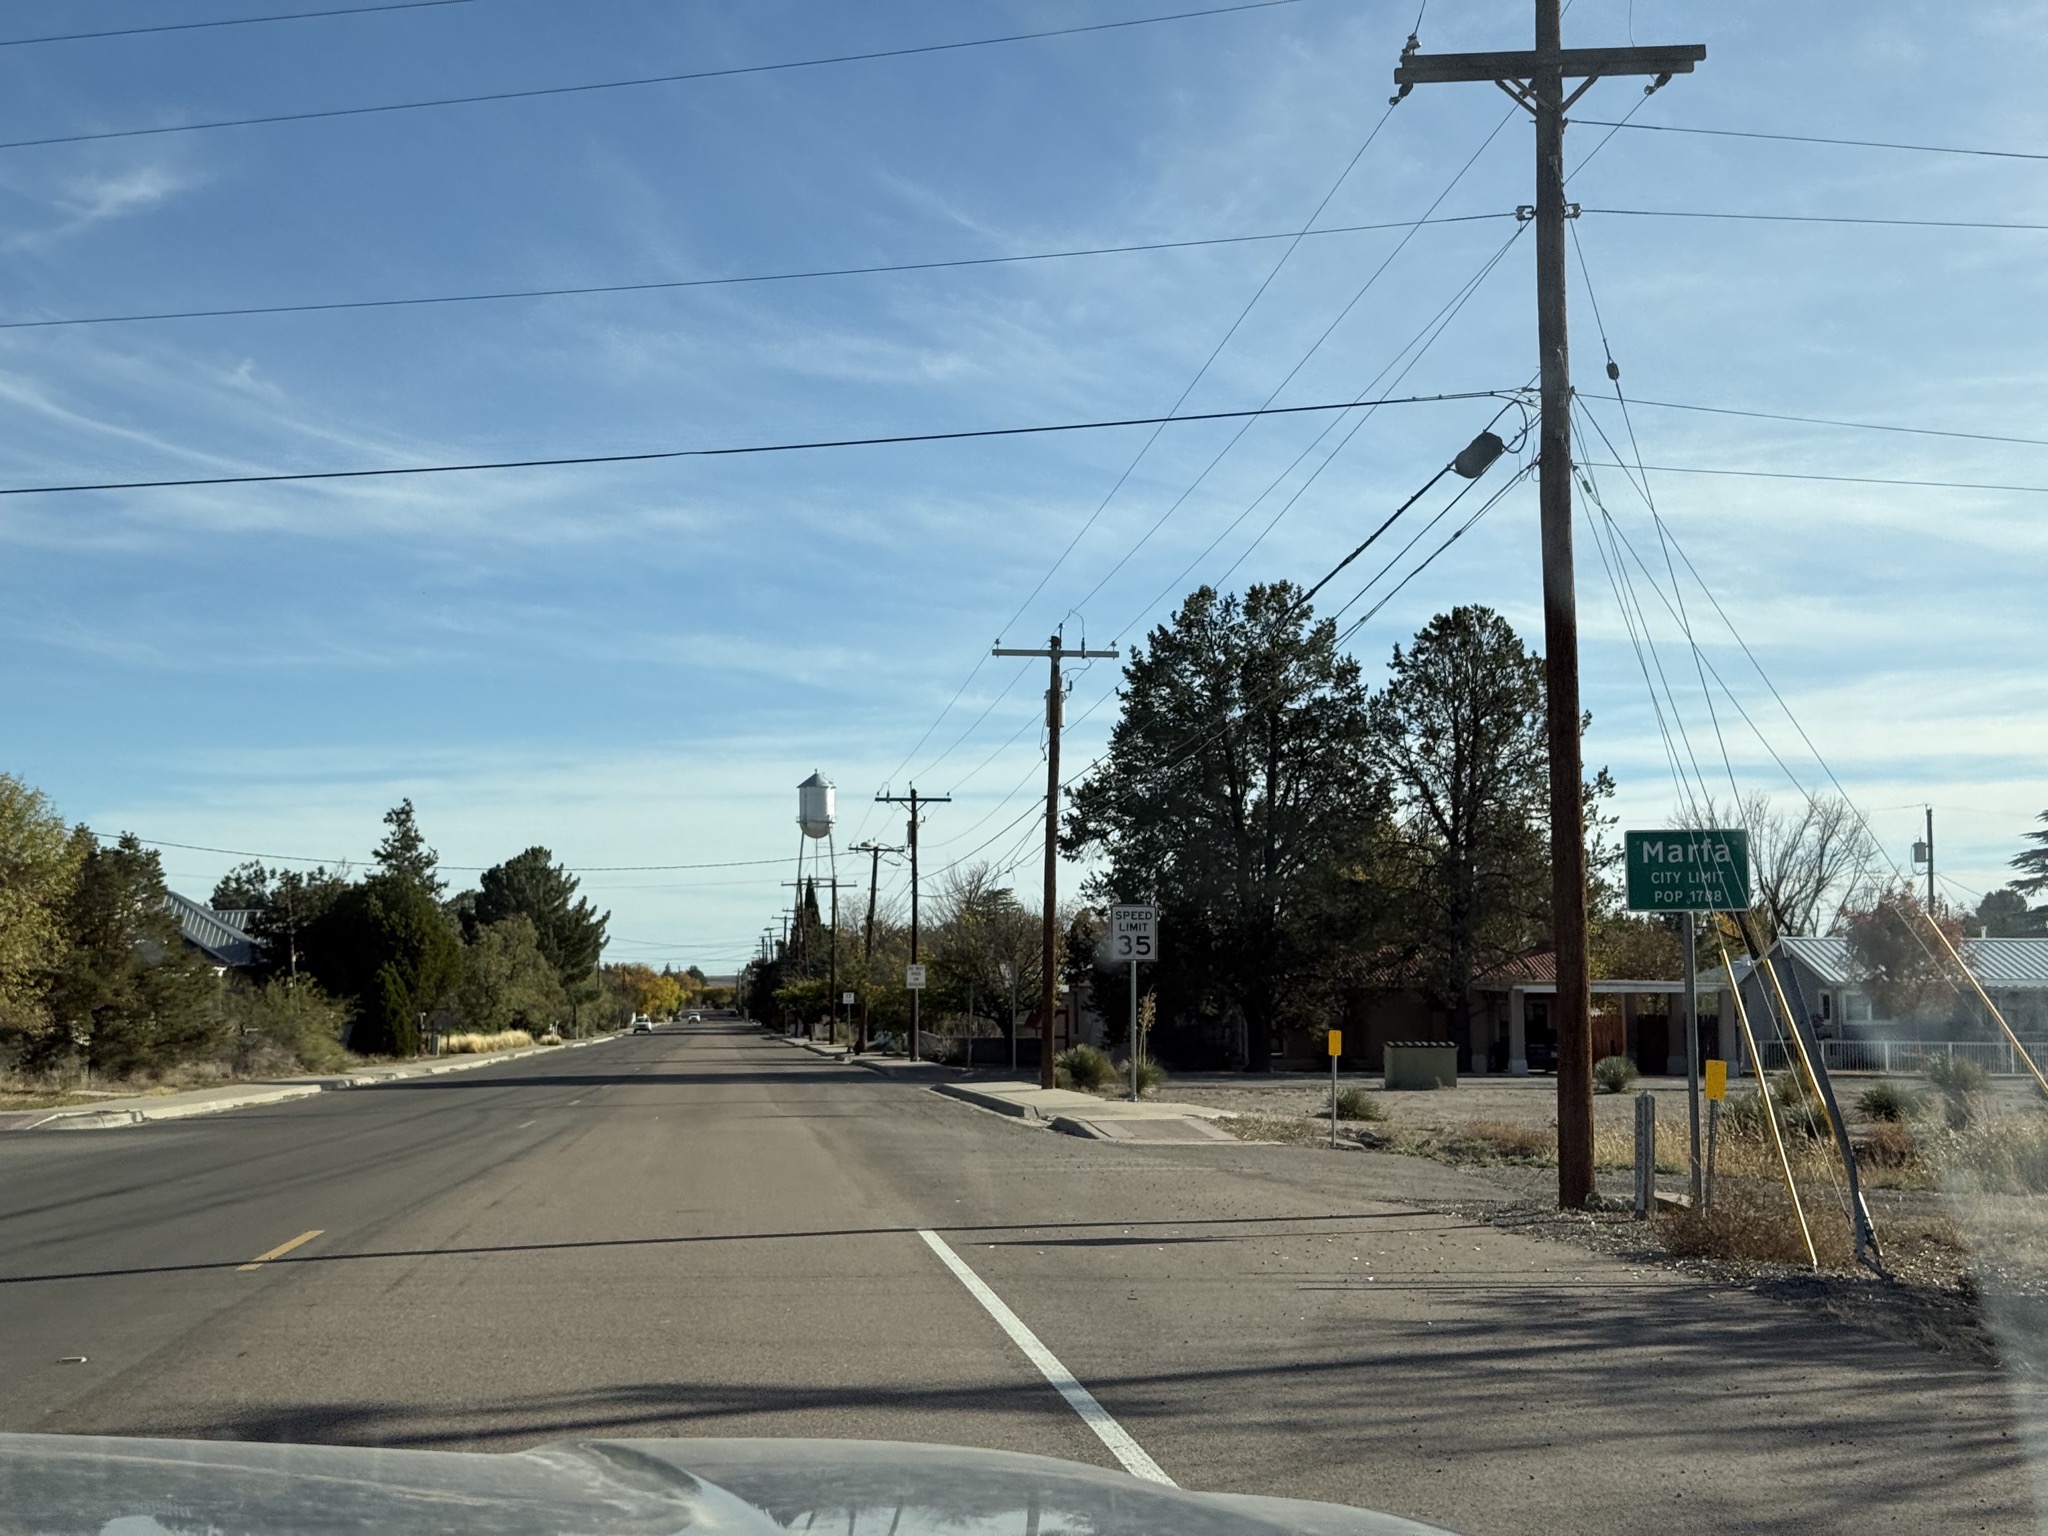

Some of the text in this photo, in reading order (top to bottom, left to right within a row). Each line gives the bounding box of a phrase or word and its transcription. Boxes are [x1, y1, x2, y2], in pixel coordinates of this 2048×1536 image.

[1642, 838, 1730, 864] Marfa
[1651, 871, 1725, 884] CITY LIMIT
[1654, 890, 1722, 903] POP 1788
[1115, 911, 1152, 920] SPEED
[1118, 922, 1149, 931] LIMIT
[1118, 935, 1151, 955] 35
